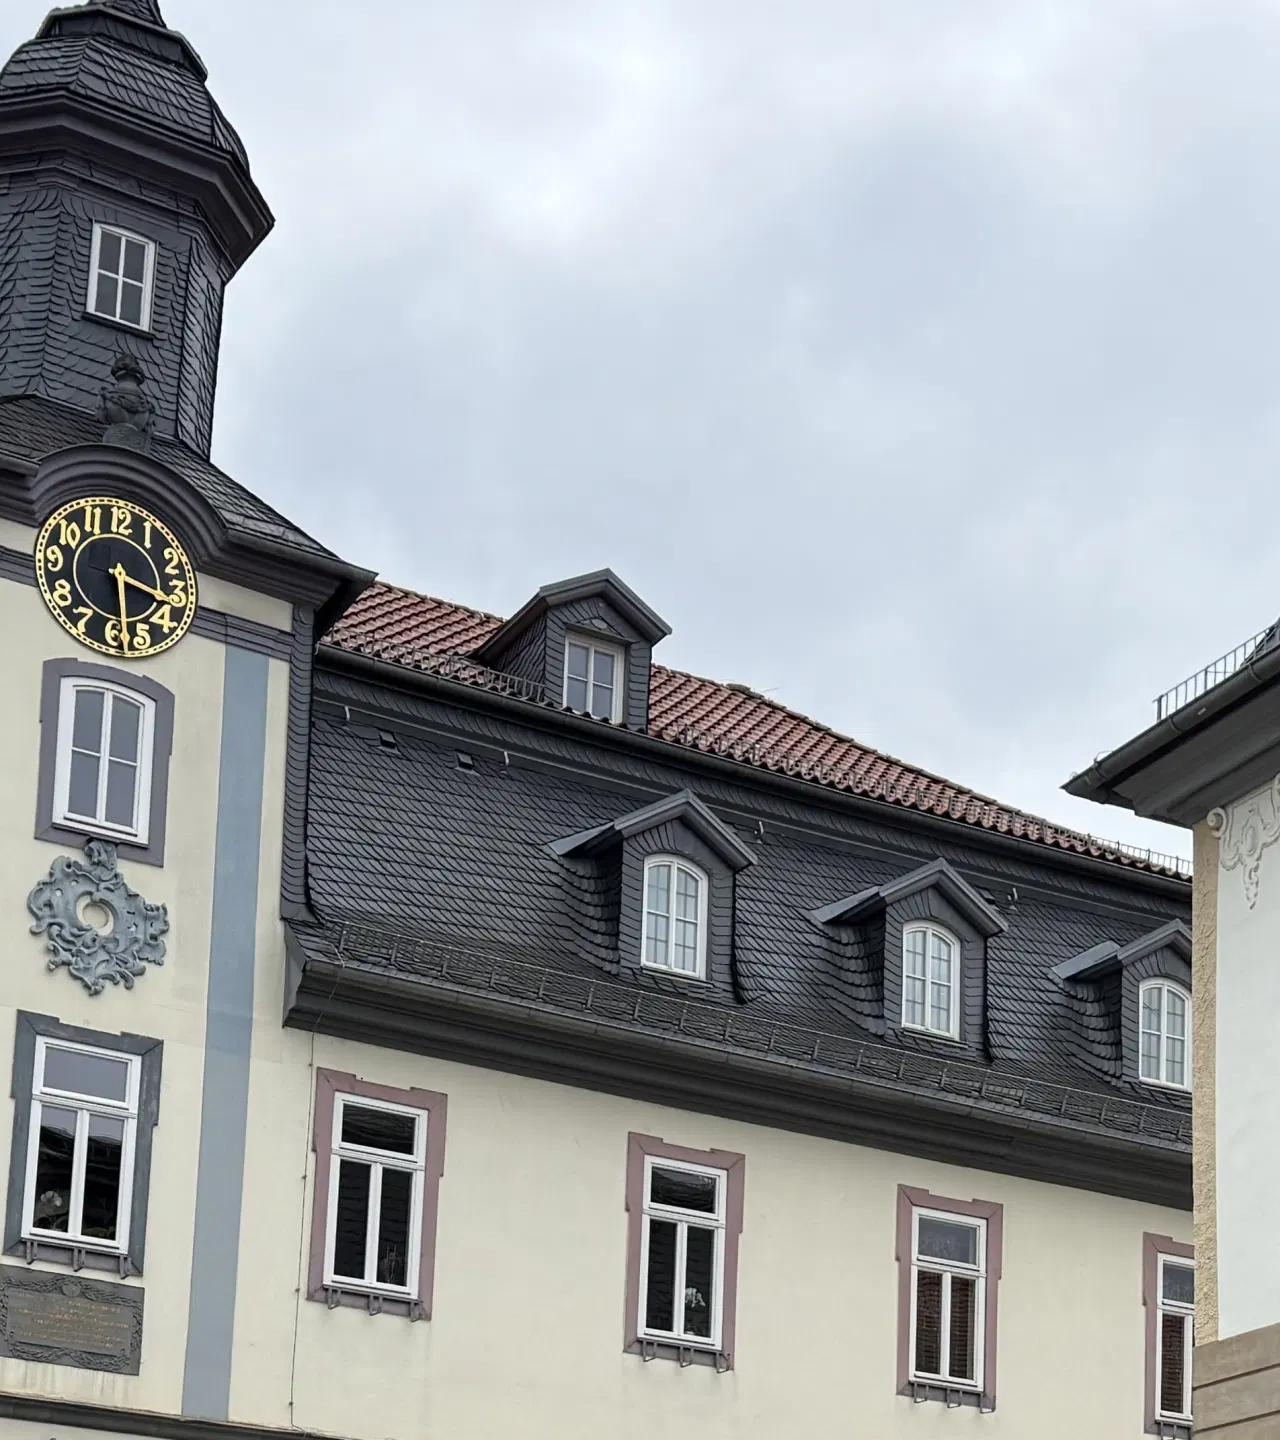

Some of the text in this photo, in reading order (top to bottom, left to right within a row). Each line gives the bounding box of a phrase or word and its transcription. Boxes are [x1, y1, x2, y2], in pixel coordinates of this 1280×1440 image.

[58, 518, 81, 550] 10
[84, 505, 102, 535] 11
[110, 506, 133, 536] 12
[142, 521, 152, 549] 1
[46, 545, 63, 572] 9
[163, 547, 180, 575] 2
[52, 578, 72, 607] 8
[169, 579, 187, 608] 3
[72, 606, 94, 633] 7
[105, 619, 123, 646] 6
[149, 604, 178, 634] 4
[133, 622, 151, 649] 5
